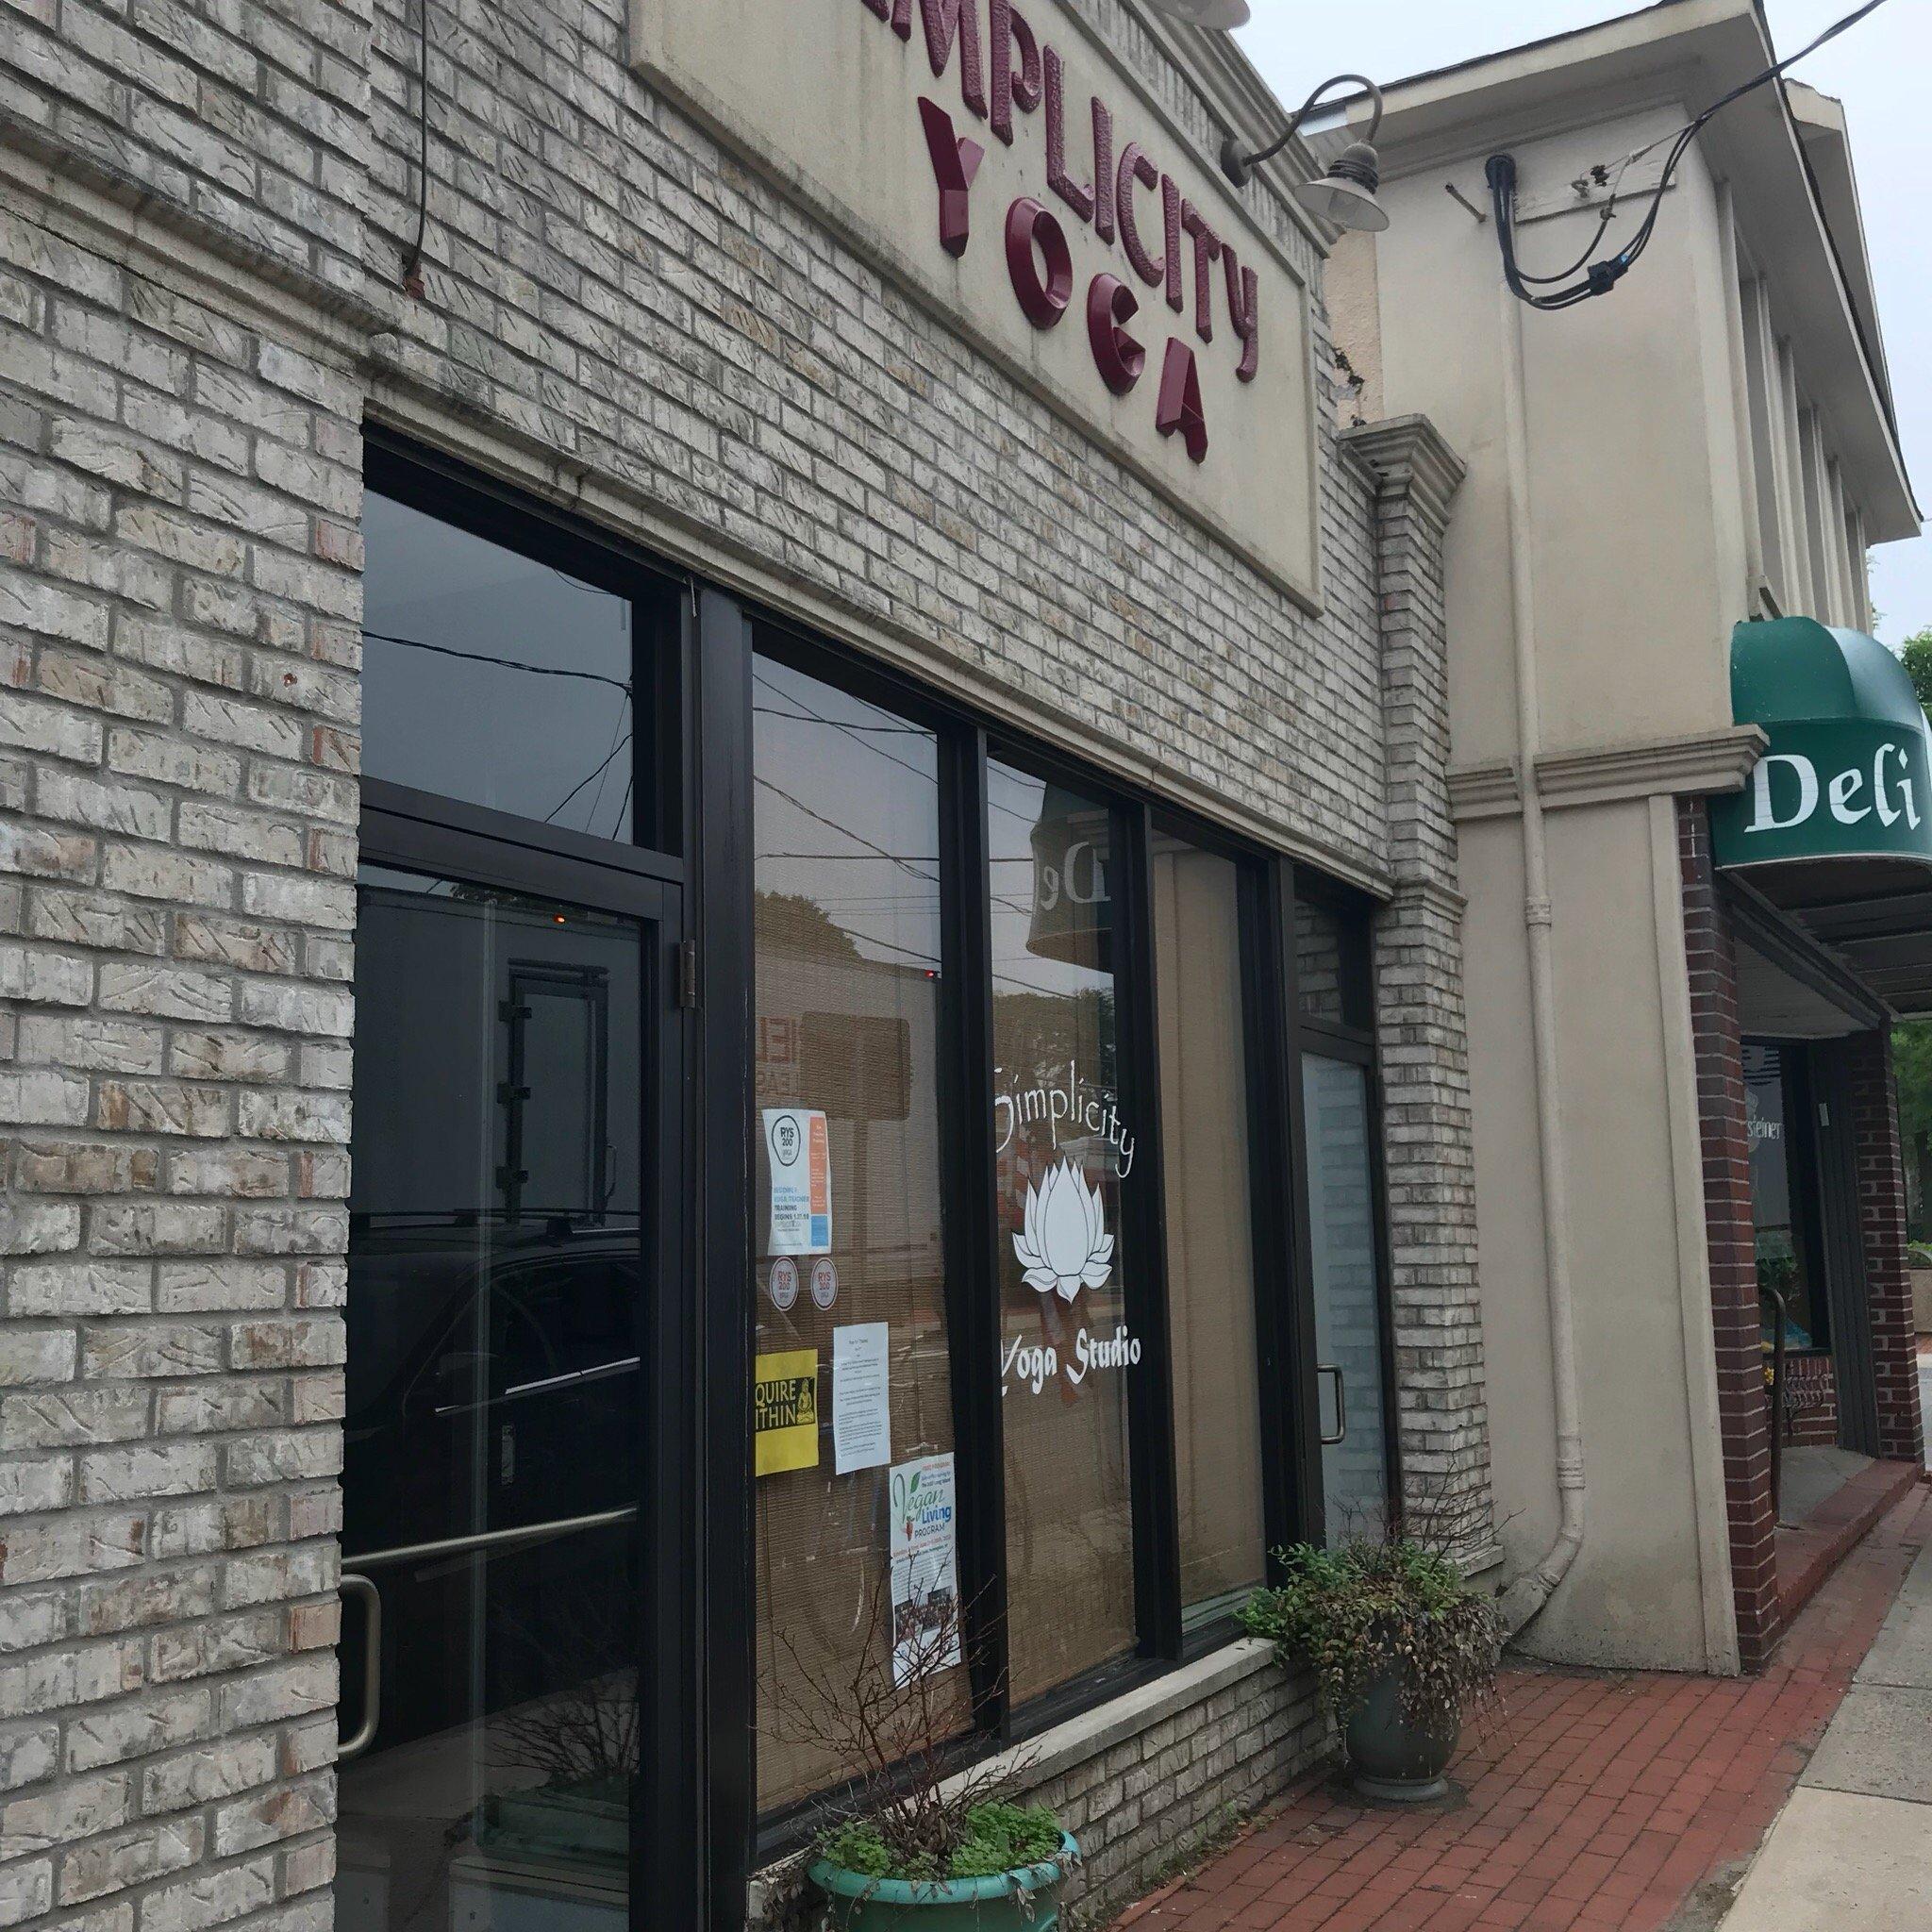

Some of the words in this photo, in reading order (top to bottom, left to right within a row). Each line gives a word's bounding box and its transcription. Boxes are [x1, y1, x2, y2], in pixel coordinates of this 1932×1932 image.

[860, 0, 1258, 383] MPLICITY
[918, 96, 1208, 464] YOGA
[1744, 743, 1921, 833] Deli
[780, 1127, 794, 1138] RYS
[782, 1138, 793, 1147] 200
[777, 1271, 791, 1281] RYS
[818, 1272, 831, 1282] RYS
[1066, 1325, 1141, 1385] Studio
[755, 1379, 796, 1407] QUIRE
[893, 1473, 945, 1524] Vegan
[922, 1505, 952, 1524] Living
[914, 1523, 945, 1539] PROGRAM
